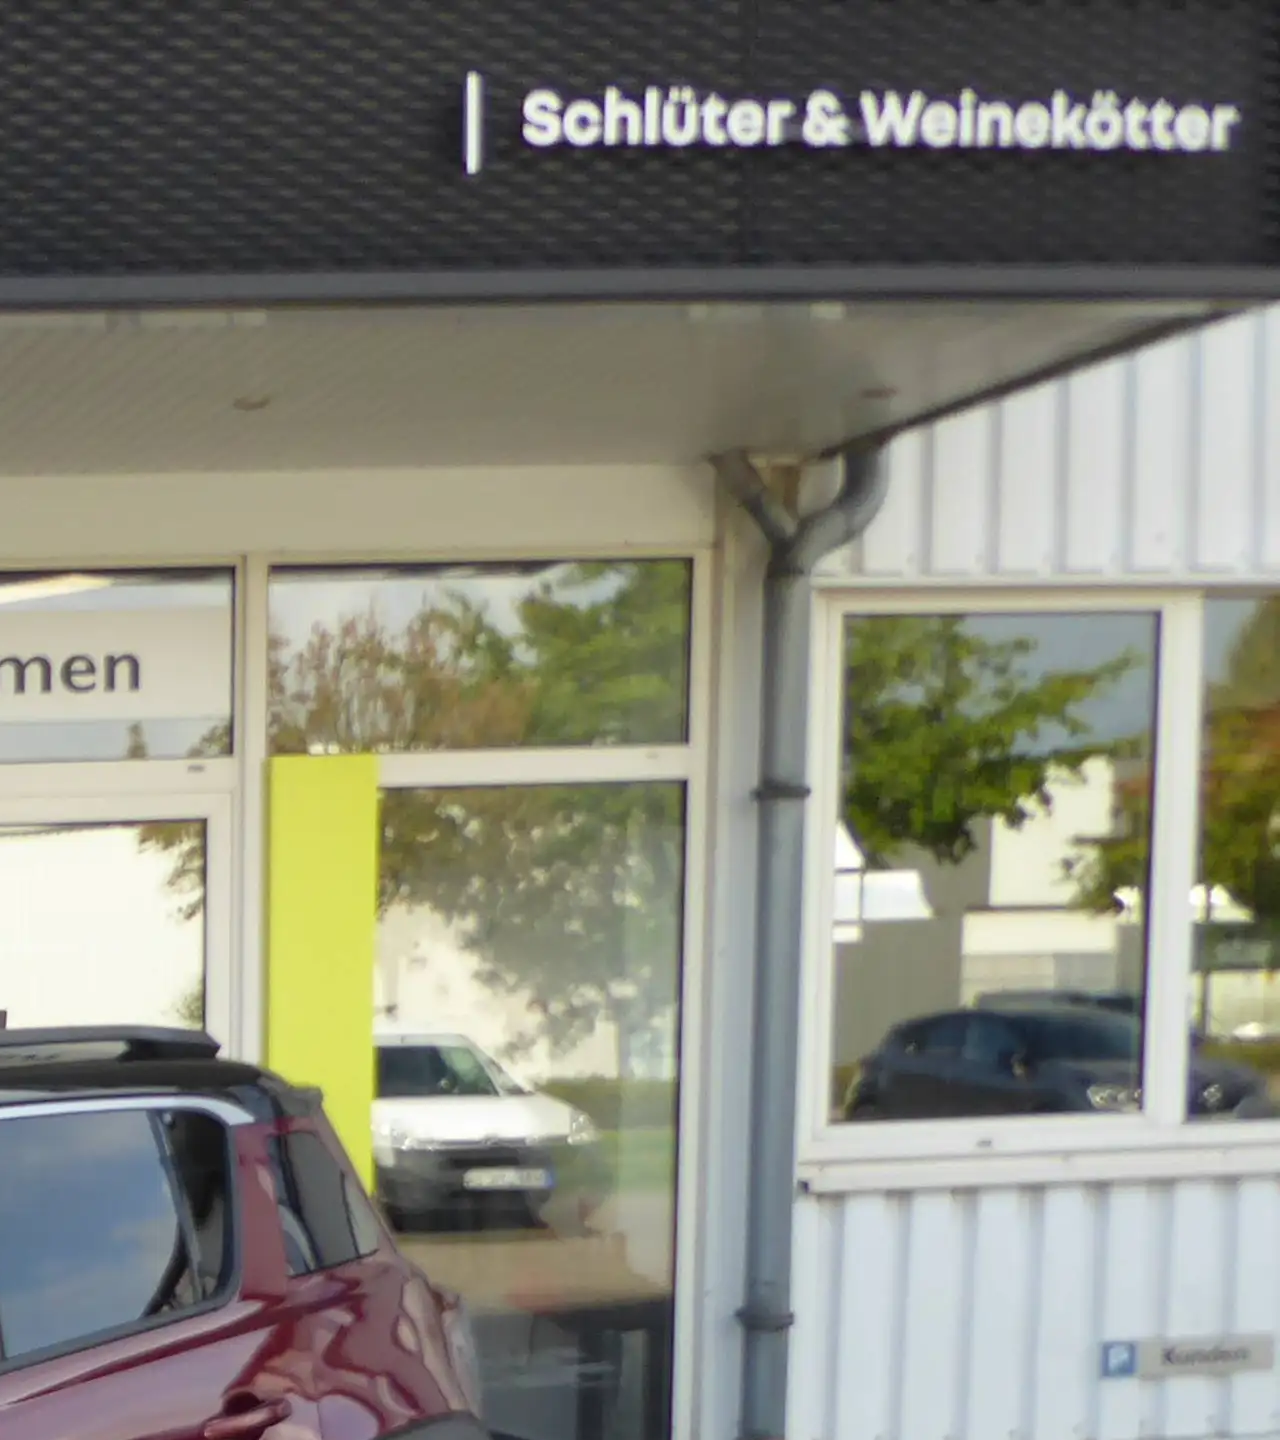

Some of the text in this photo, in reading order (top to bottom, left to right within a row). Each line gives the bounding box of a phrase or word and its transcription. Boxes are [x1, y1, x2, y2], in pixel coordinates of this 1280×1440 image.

[521, 86, 1239, 151] Schlüter & Weinekötter
